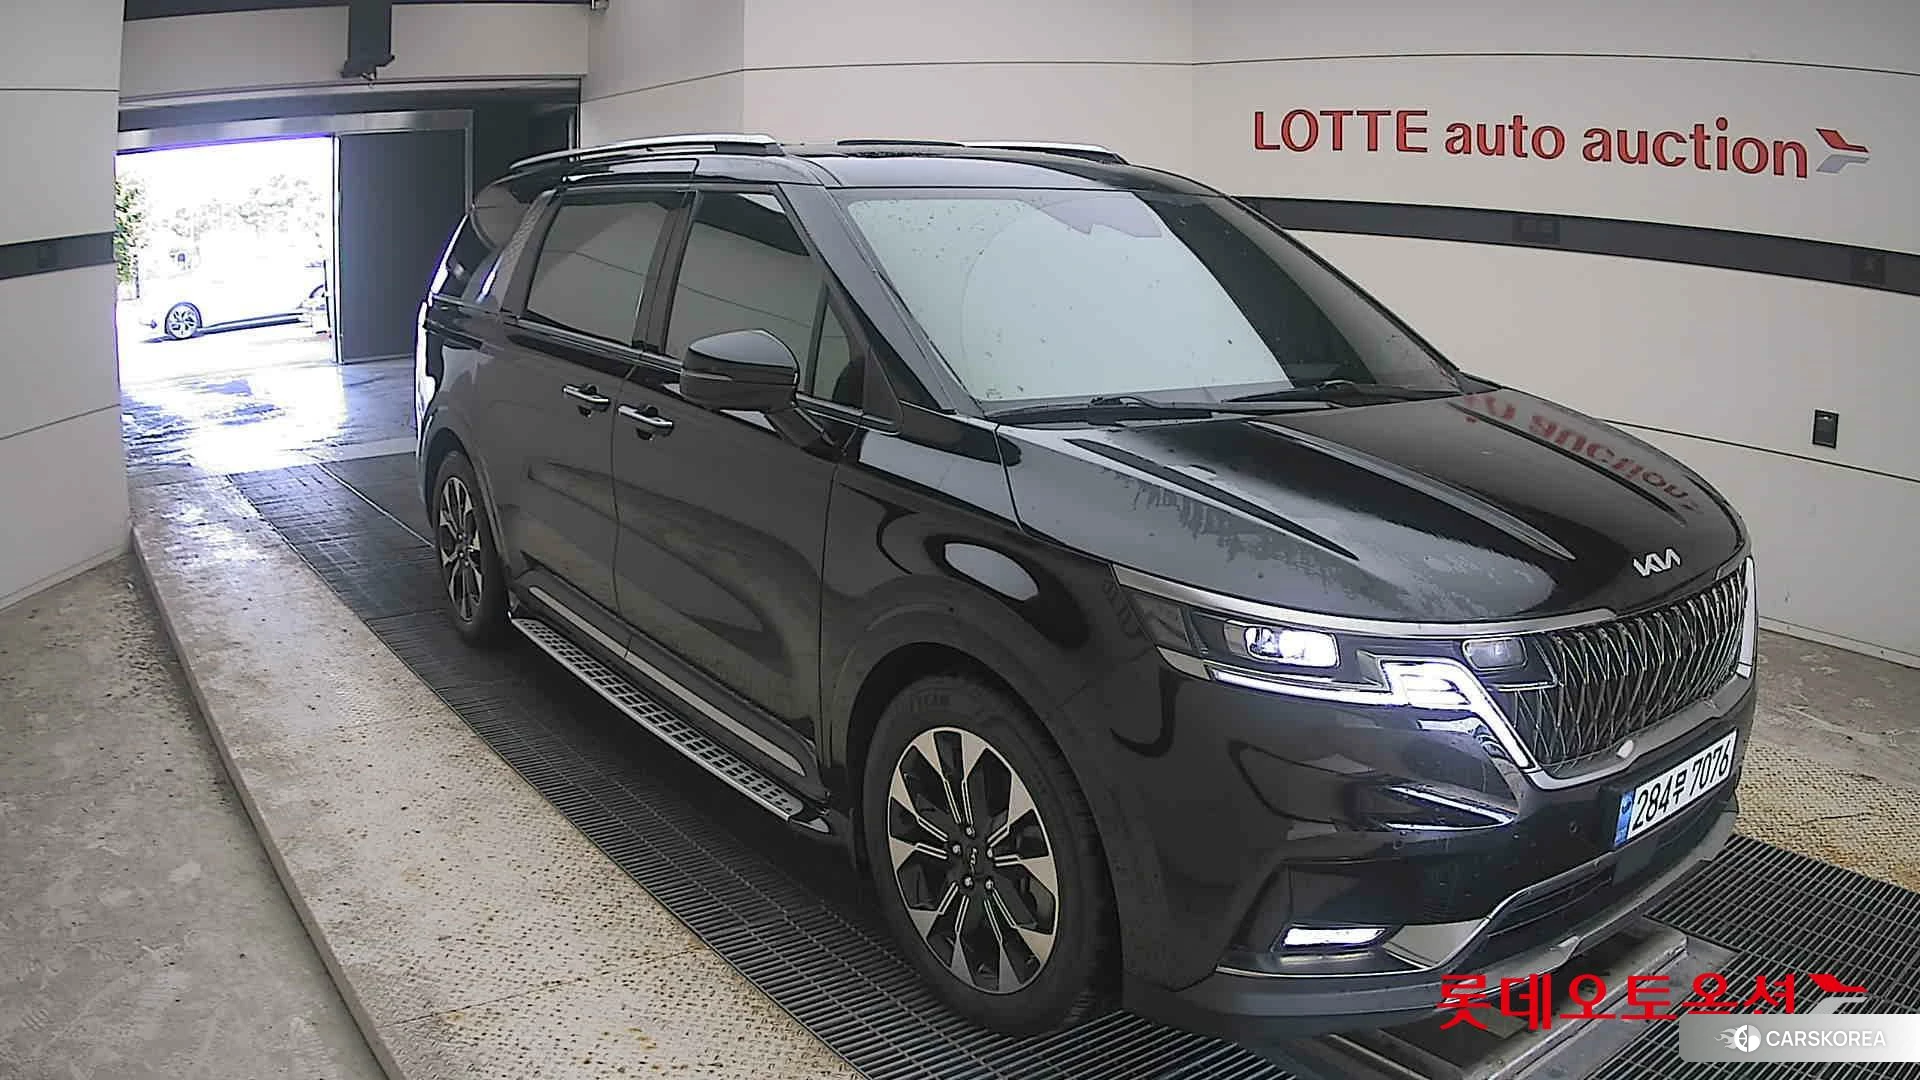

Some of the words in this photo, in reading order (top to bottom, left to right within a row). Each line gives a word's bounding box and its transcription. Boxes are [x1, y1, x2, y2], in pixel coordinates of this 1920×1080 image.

[1253, 109, 1428, 153] LOTTE
[1444, 114, 1566, 160] auto
[1581, 116, 1808, 178] auction
[1632, 768, 1688, 831] 284무
[1689, 740, 1732, 796] 7076
